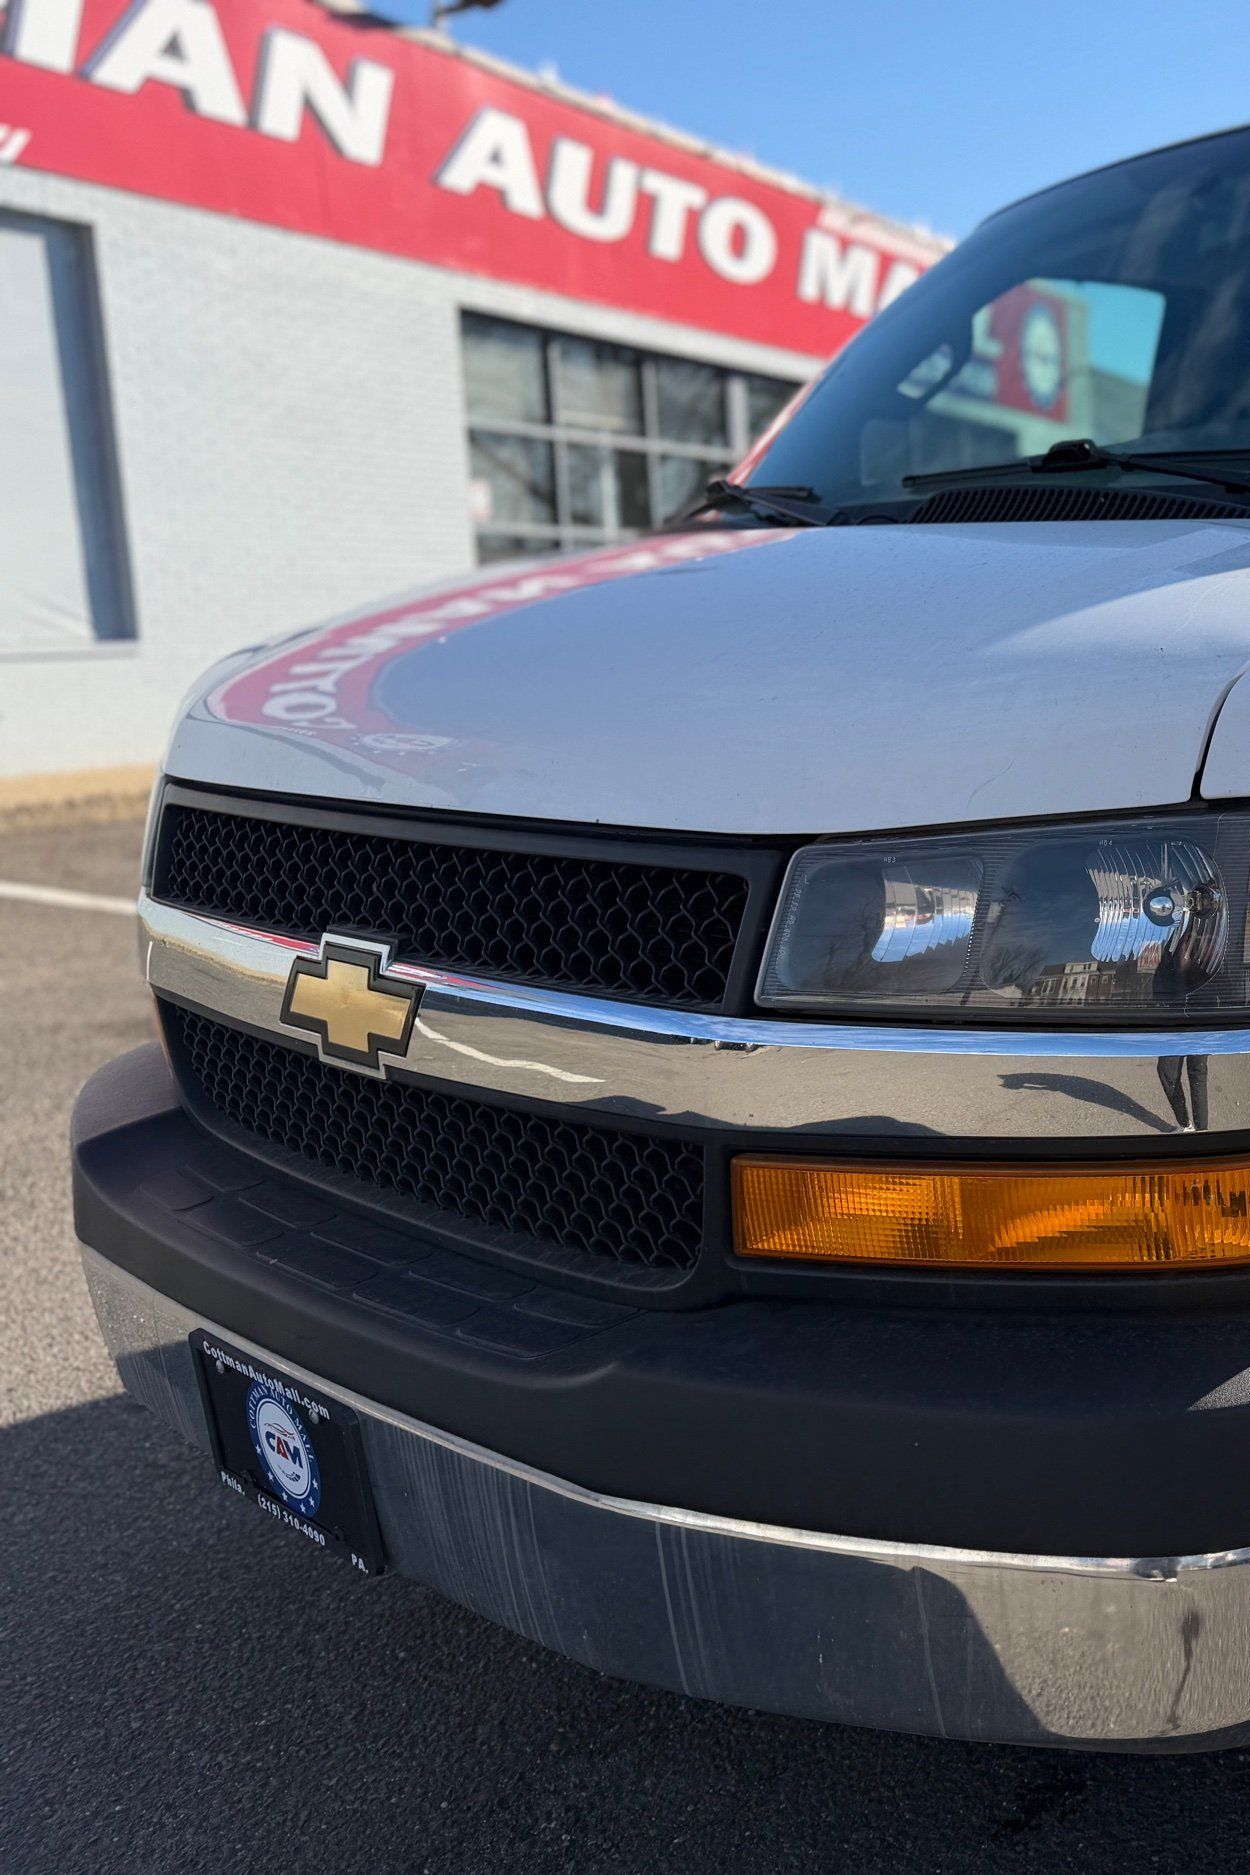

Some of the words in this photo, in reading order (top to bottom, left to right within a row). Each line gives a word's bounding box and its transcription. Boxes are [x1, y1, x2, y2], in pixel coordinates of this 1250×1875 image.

[434, 106, 778, 285] AUTO
[202, 1340, 331, 1421] CottmanAutoMall.com
[248, 1385, 268, 1429] COTTMAN
[270, 1388, 294, 1415] AUTO
[295, 1417, 316, 1463] MALL
[220, 1471, 246, 1496] Phila.
[257, 1494, 281, 1520] (215)
[283, 1506, 326, 1547] 310-4090
[351, 1552, 369, 1574] PA.
